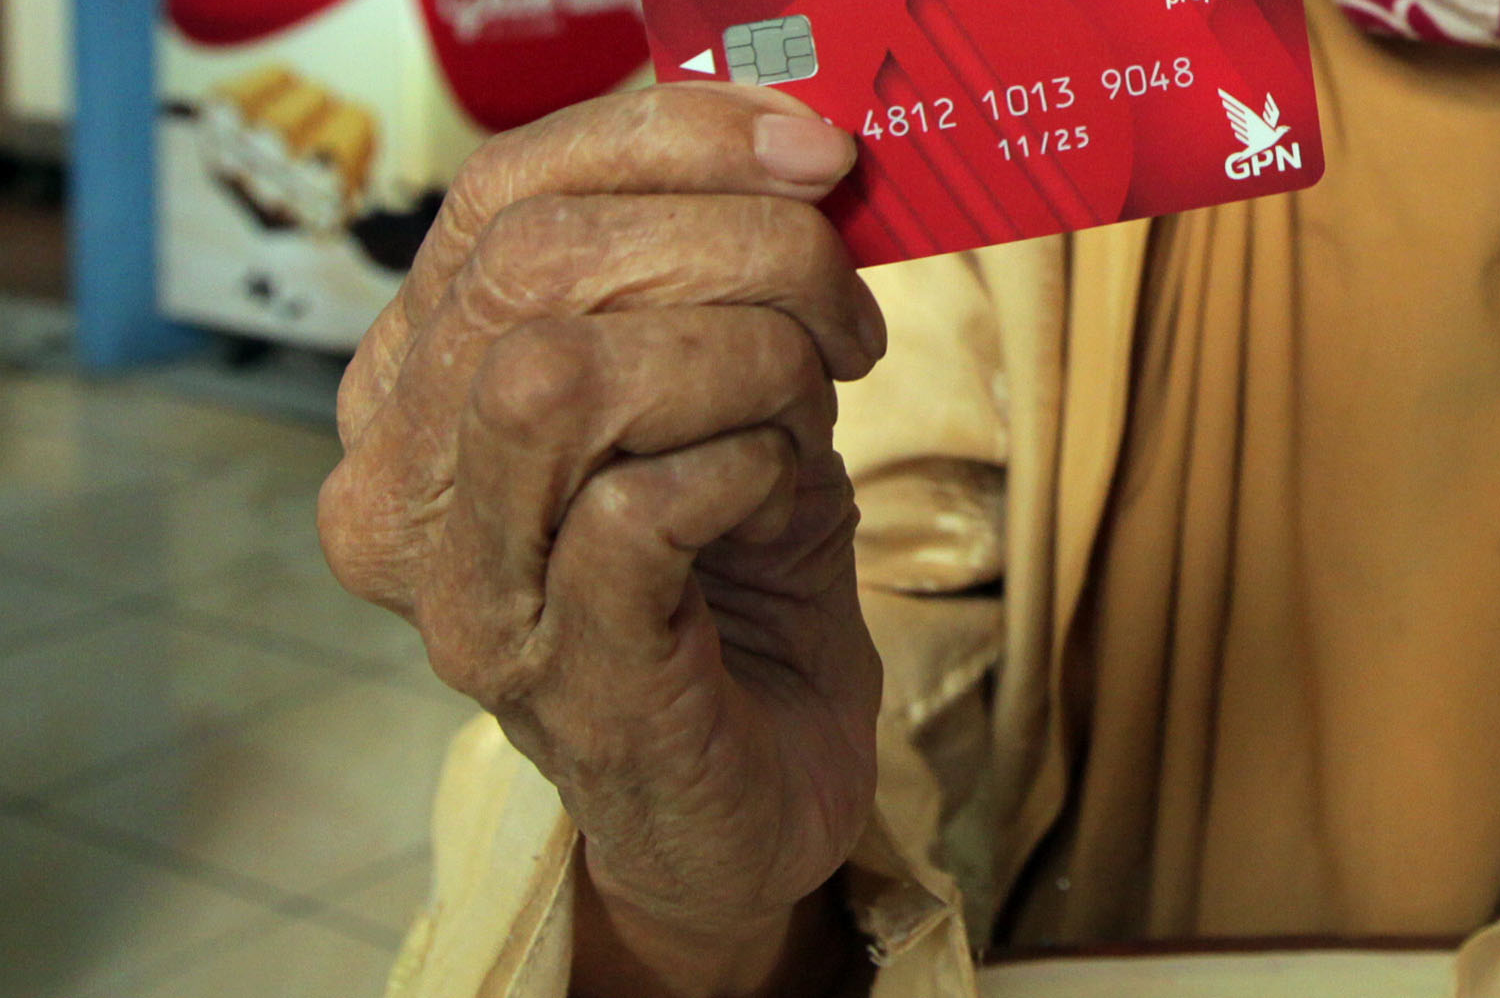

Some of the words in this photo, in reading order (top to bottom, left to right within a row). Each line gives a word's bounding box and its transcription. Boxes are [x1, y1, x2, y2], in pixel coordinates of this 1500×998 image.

[862, 97, 957, 141] 4812
[982, 76, 1076, 121] 1013
[1100, 56, 1195, 101] 9048
[998, 125, 1090, 162] 11/25
[1224, 142, 1302, 180] GPN
